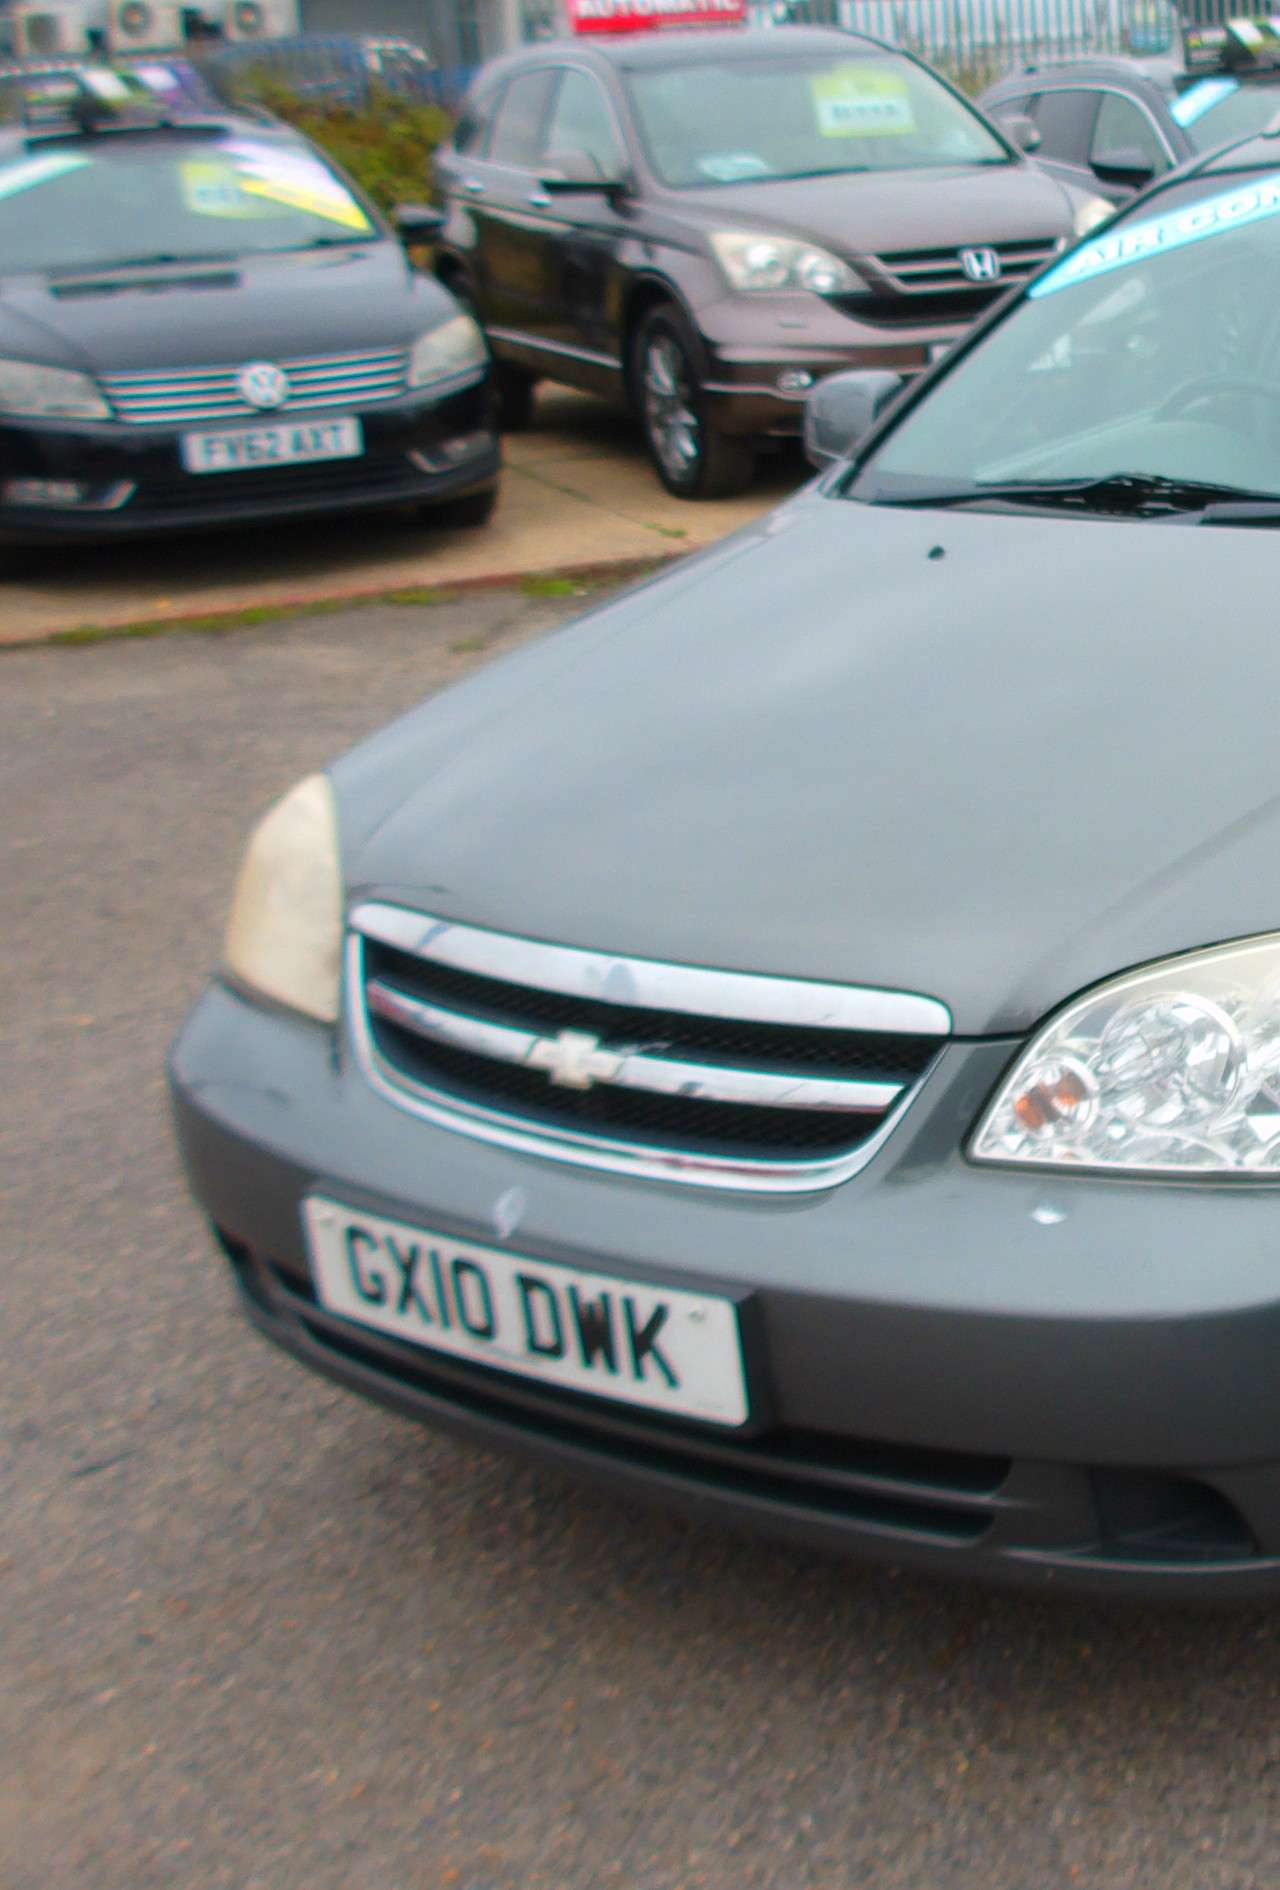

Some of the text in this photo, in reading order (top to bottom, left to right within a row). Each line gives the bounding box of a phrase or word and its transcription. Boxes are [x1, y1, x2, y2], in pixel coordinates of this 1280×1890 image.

[1064, 224, 1166, 274] AIR
[202, 423, 345, 464] FV62 AXT
[344, 1224, 681, 1390] GX10 DWK
